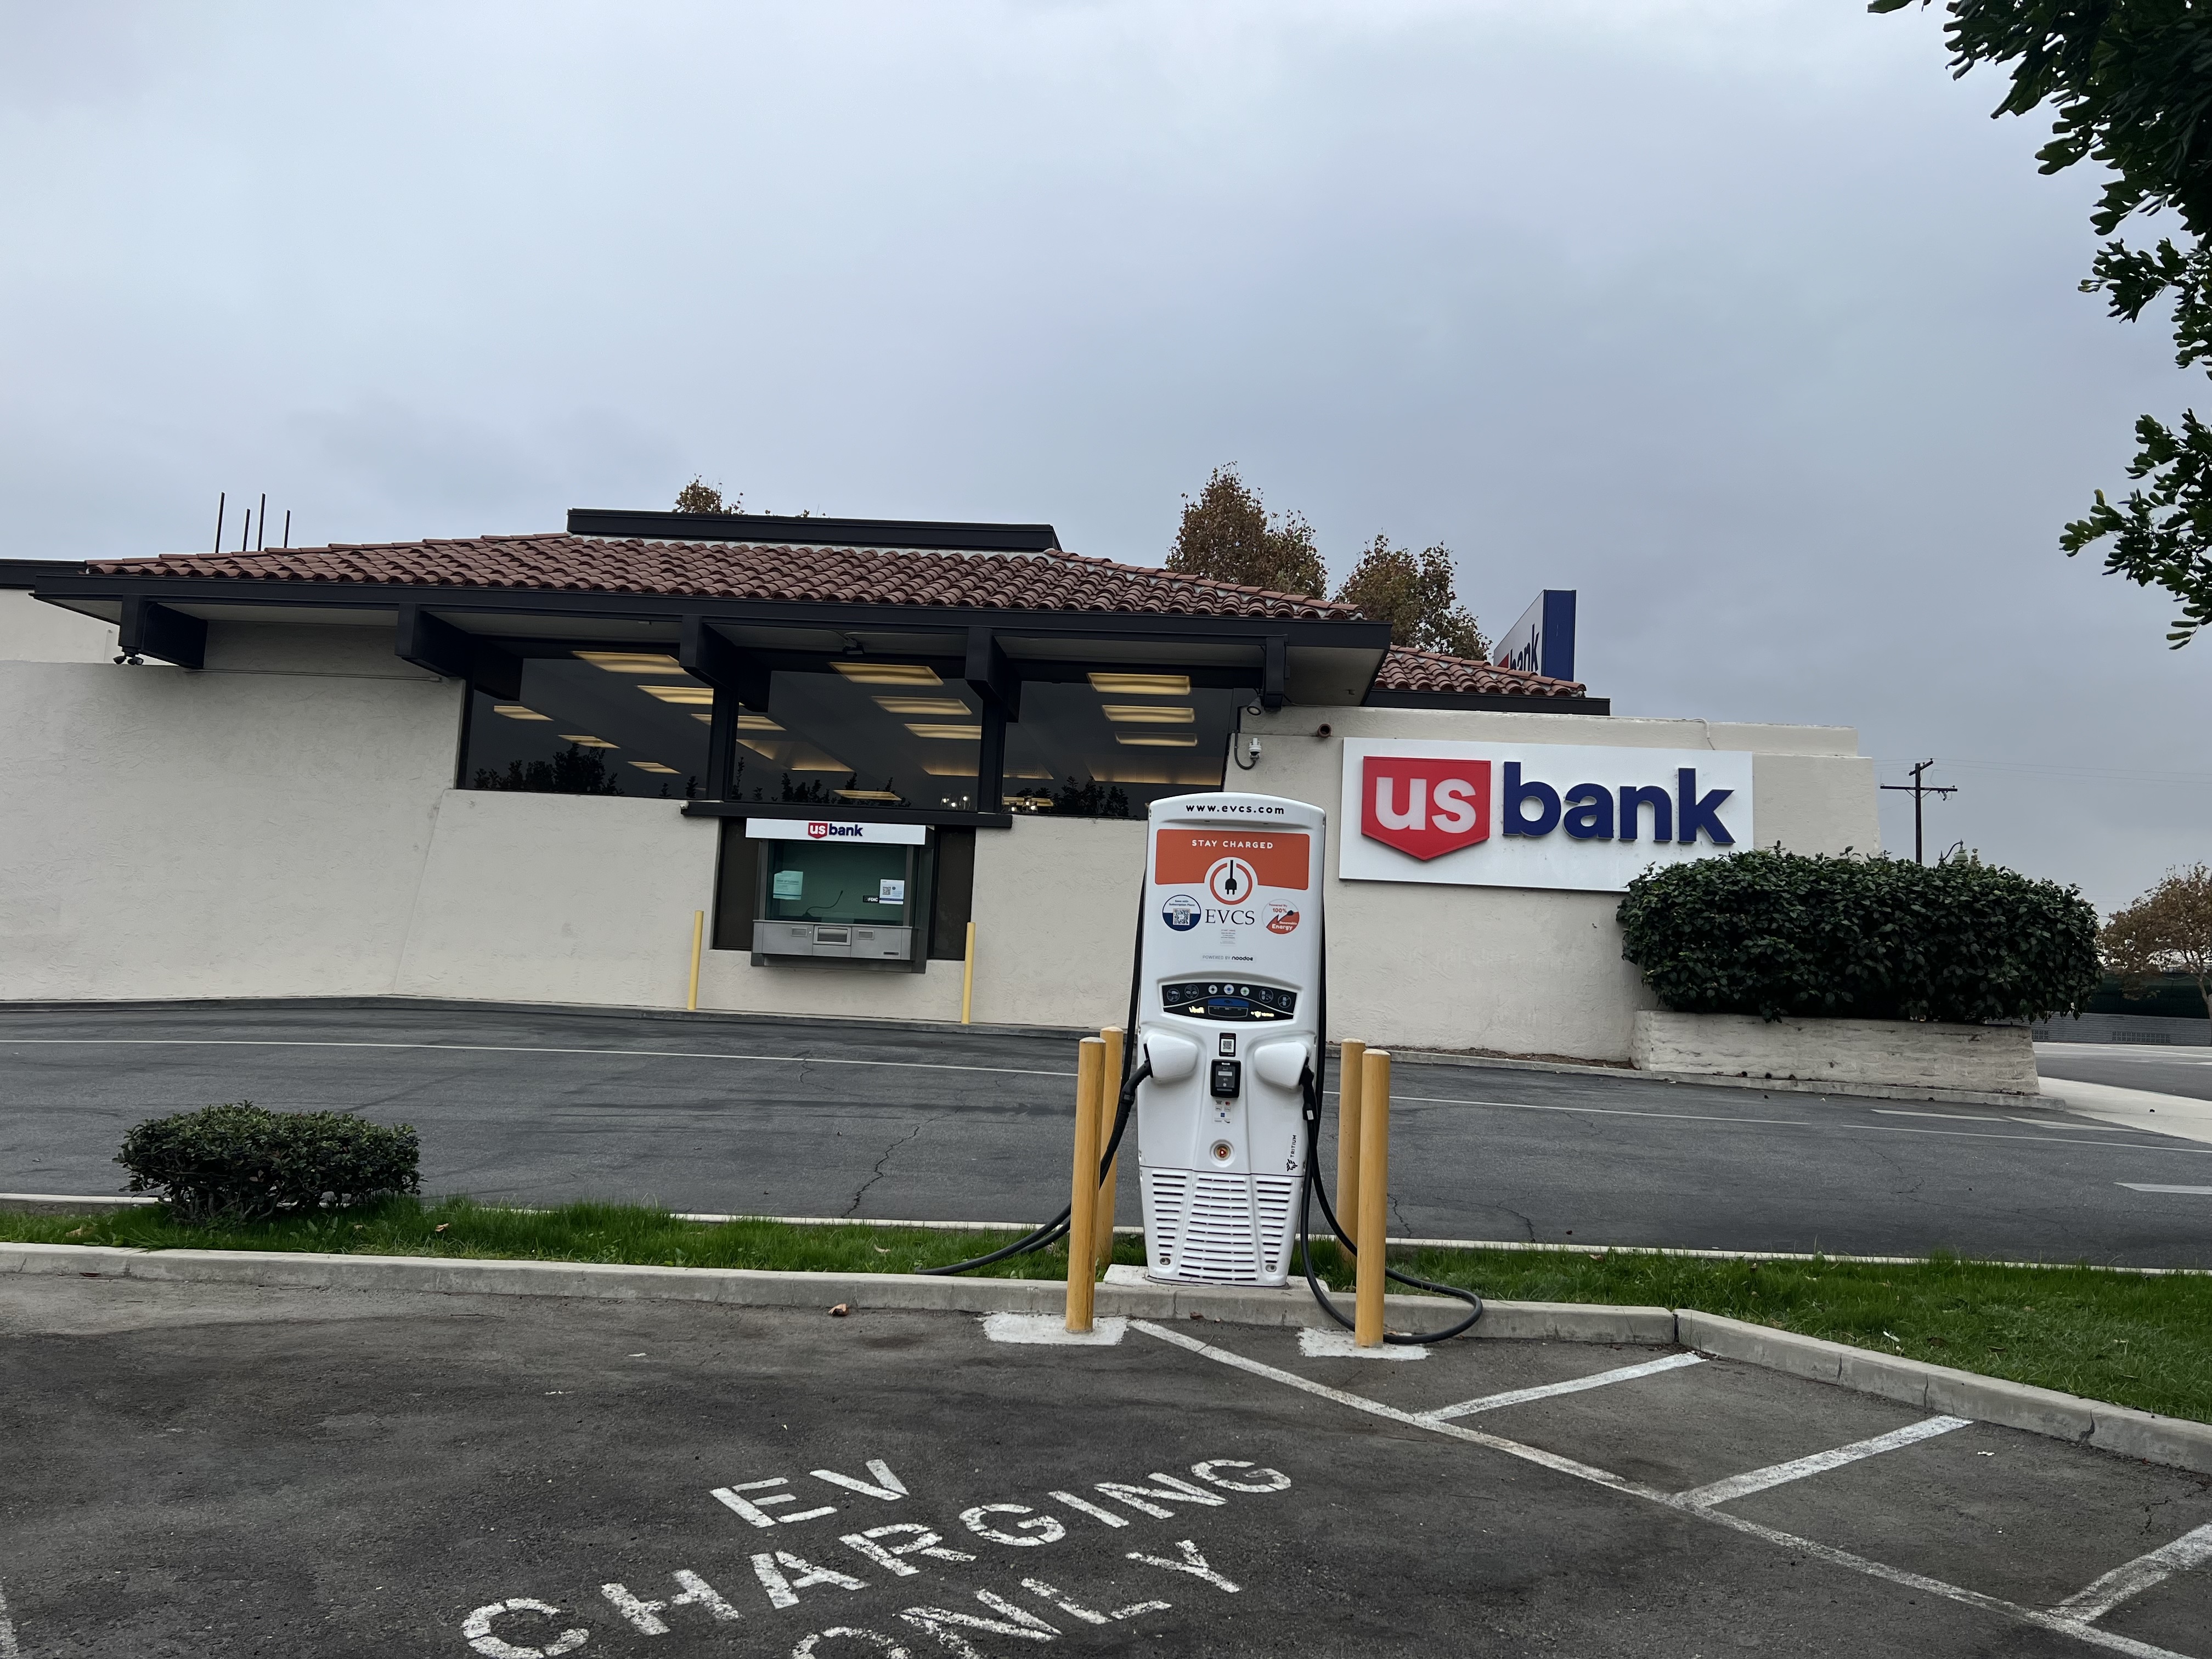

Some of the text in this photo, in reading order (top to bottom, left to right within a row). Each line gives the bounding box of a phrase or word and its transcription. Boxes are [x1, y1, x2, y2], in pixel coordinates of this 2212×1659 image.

[1510, 623, 1539, 672] bank
[1186, 805, 1284, 815] www.evcs.com
[1502, 761, 1736, 845] bank
[828, 823, 864, 837] bank
[1222, 840, 1273, 849] CHARGED
[1205, 909, 1255, 926] EVCS
[709, 1459, 909, 1528] EV
[461, 1459, 1292, 1659] CHARGING
